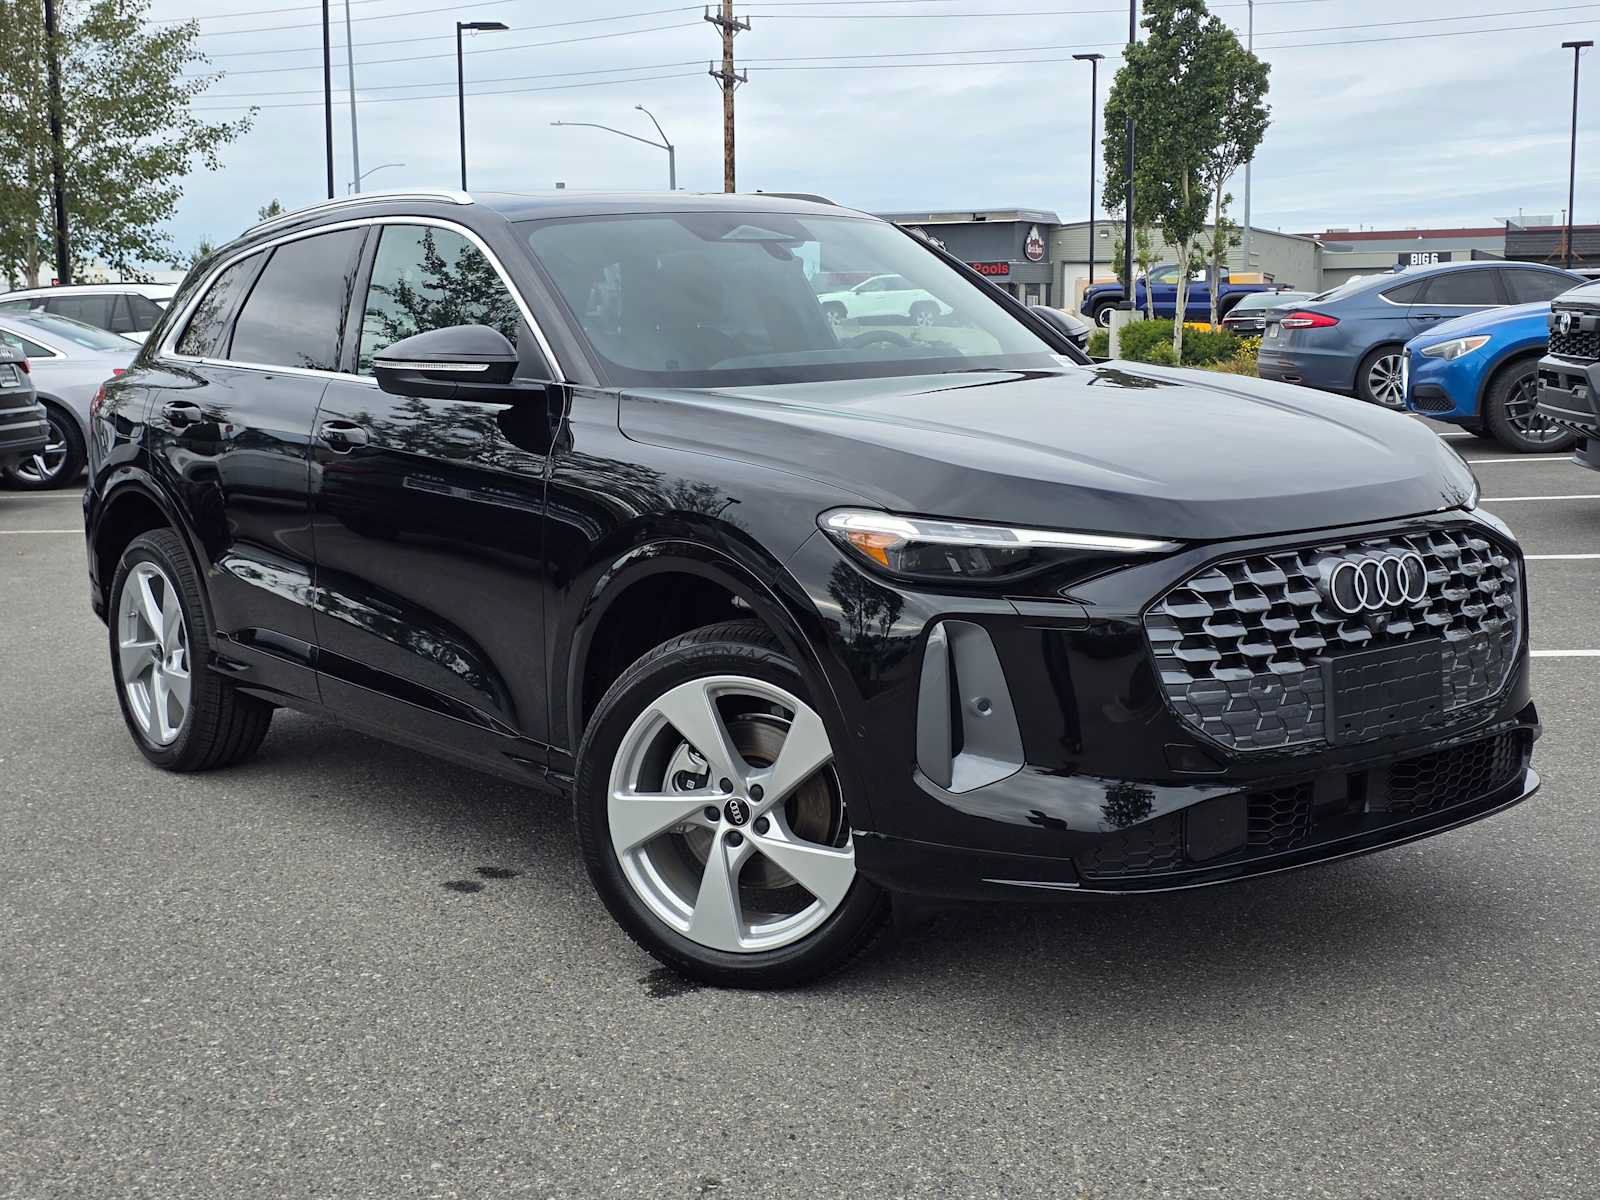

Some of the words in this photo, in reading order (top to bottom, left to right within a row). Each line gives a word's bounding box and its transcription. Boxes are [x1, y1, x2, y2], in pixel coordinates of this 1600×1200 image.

[1411, 253, 1430, 265] BIG
[1431, 253, 1439, 265] 6
[974, 263, 1009, 274] Pools
